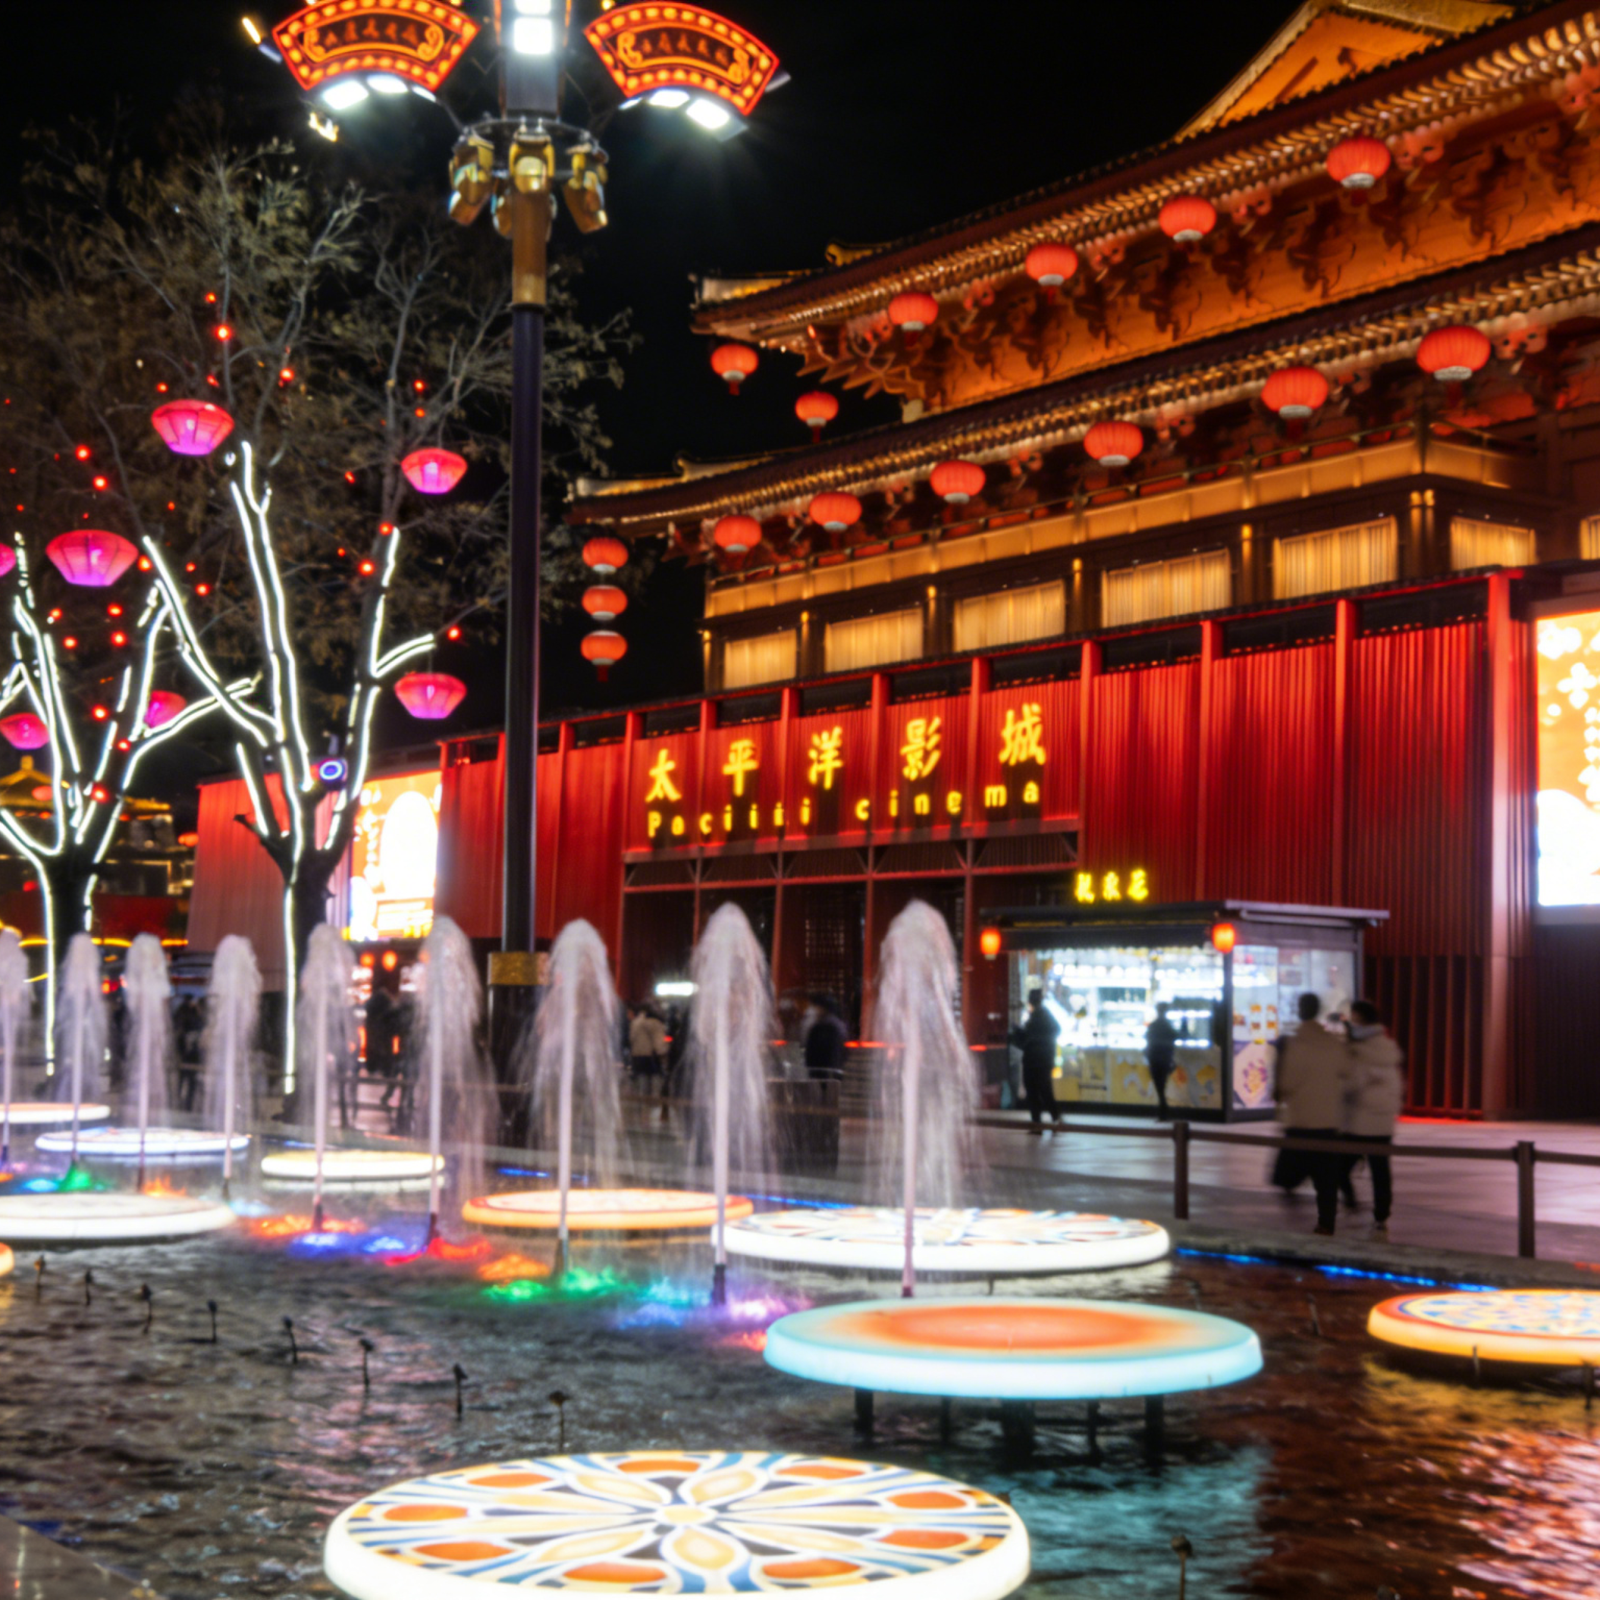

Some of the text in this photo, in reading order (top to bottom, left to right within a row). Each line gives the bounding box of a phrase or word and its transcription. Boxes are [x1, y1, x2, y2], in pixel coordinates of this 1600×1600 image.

[645, 702, 1046, 802] 太平洋影城
[854, 781, 1040, 821] cinema
